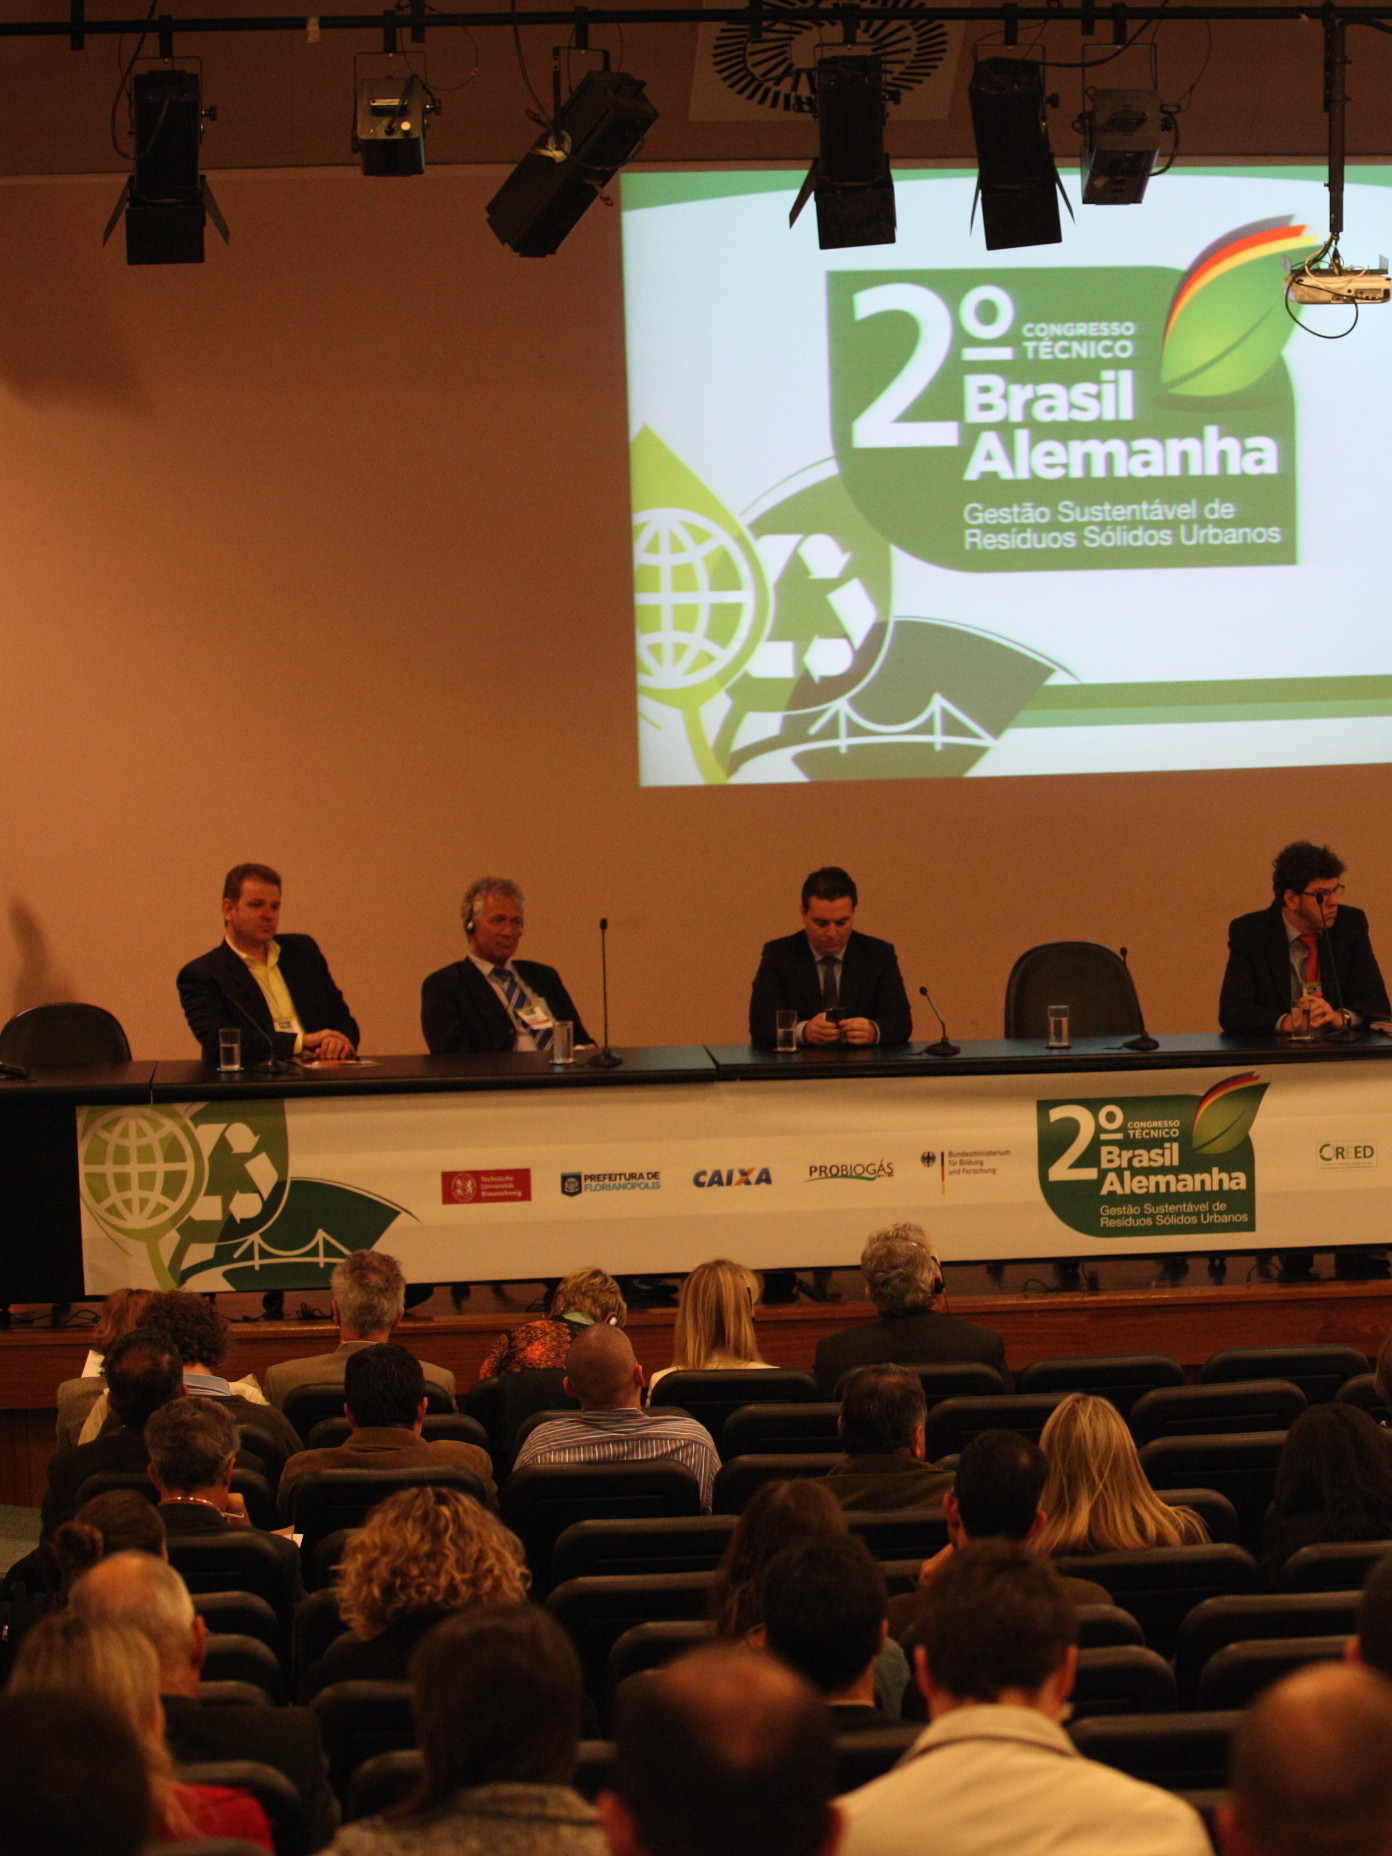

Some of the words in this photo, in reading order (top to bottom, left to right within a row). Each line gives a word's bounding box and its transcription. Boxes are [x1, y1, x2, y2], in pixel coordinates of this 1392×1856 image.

[1022, 321, 1135, 338] CONGRESSO
[1022, 337, 1134, 359] TÉCNICO
[963, 369, 1134, 423] Brasil
[963, 425, 1278, 480] Alemanha
[963, 502, 1051, 525] Gestão
[1057, 499, 1197, 522] Sustentável
[1205, 500, 1235, 519] de
[965, 527, 1077, 550] Resíduos
[1084, 525, 1173, 547] Sólidos
[1181, 525, 1282, 546] Urbanos
[1127, 1120, 1180, 1129] CONGRESSO
[1128, 1127, 1179, 1139] TÉCNICO
[948, 1149, 1011, 1158] Bundesministerium
[1100, 1142, 1179, 1169] Brasil
[959, 1159, 984, 1167] Bildung
[962, 1167, 996, 1175] Forschung
[584, 1172, 644, 1182] PREFEITURA
[646, 1171, 660, 1180] DE
[692, 1167, 773, 1188] CAIXA
[1100, 1167, 1247, 1195] Alemanha
[480, 1190, 522, 1198] Braunschweig
[1100, 1203, 1141, 1216] Gestão
[1144, 1202, 1209, 1214] Sustentável
[1212, 1201, 1227, 1212] de
[1100, 1217, 1152, 1228] Resíduos
[1156, 1214, 1198, 1225] Sólidos
[1201, 1213, 1248, 1224] Urbanos
